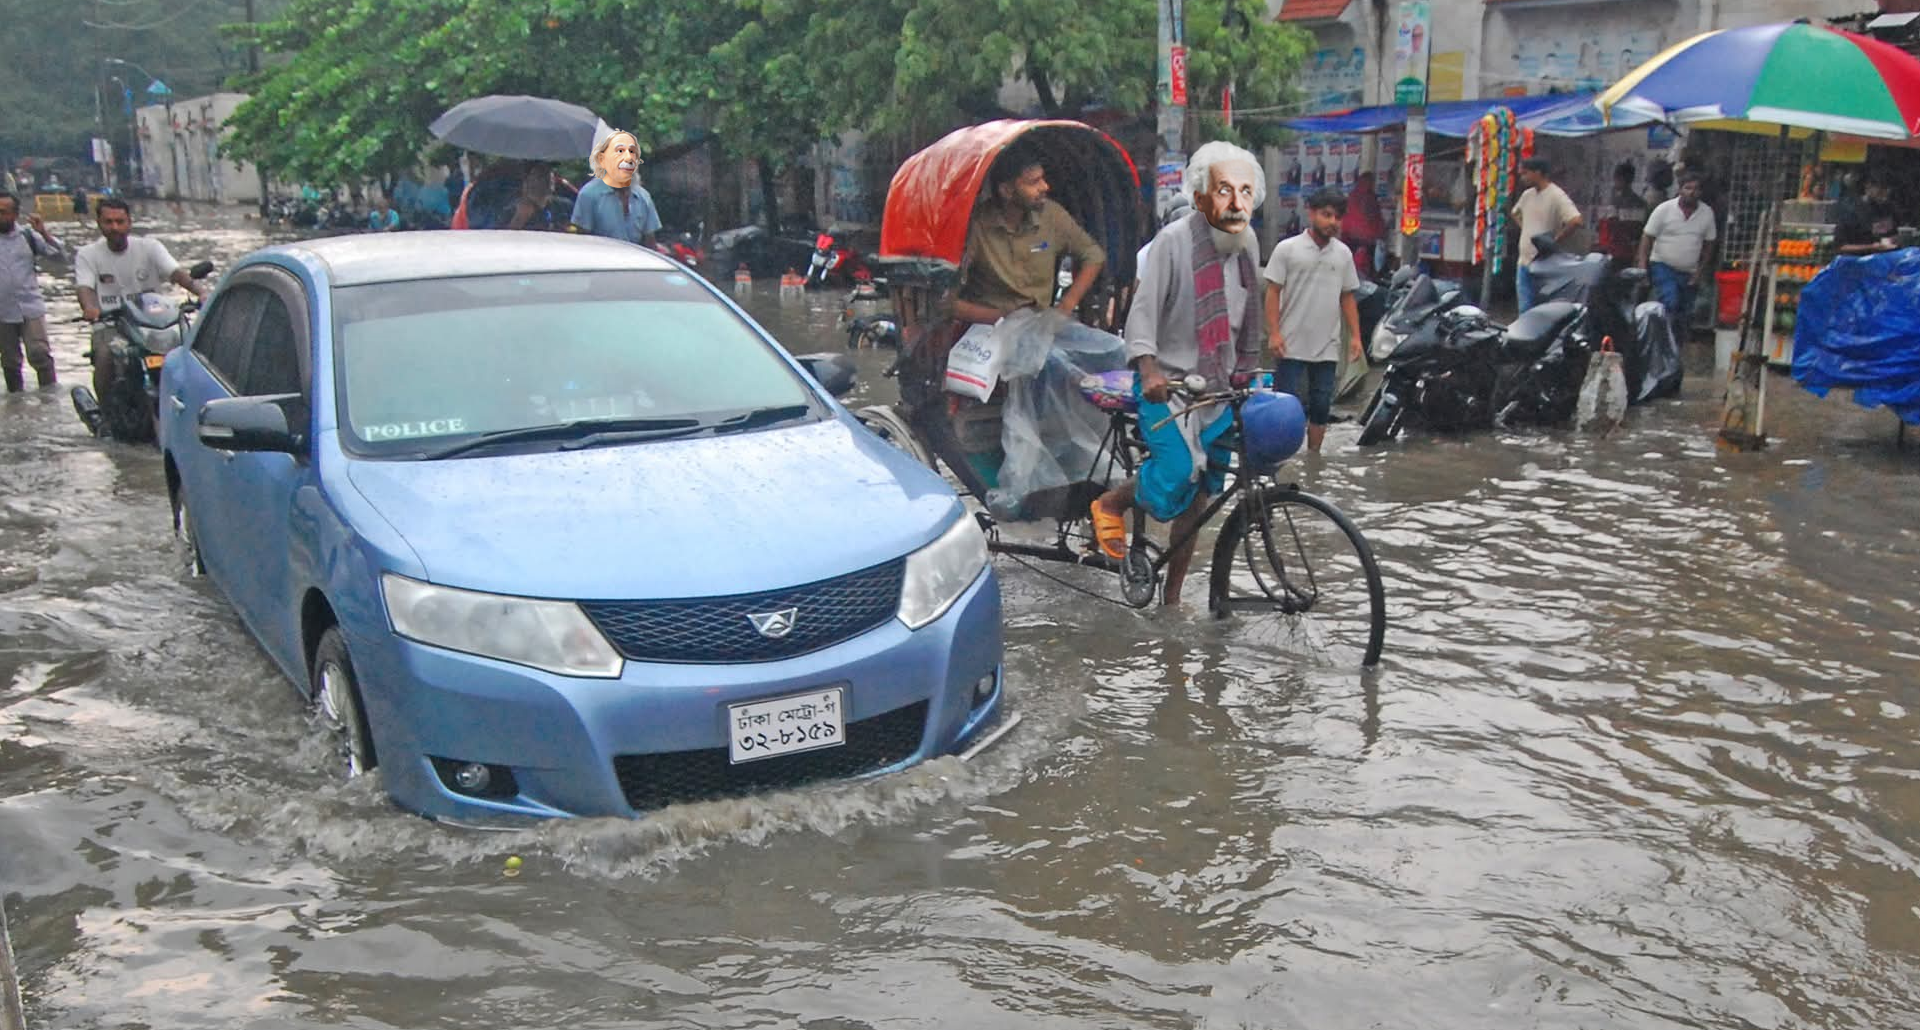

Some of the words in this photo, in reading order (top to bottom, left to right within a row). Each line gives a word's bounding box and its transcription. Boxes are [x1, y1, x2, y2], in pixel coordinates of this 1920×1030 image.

[364, 418, 464, 441] POLICE
[737, 712, 771, 730] ঢাকা
[738, 721, 837, 751] ৩২-৮১৫৯
